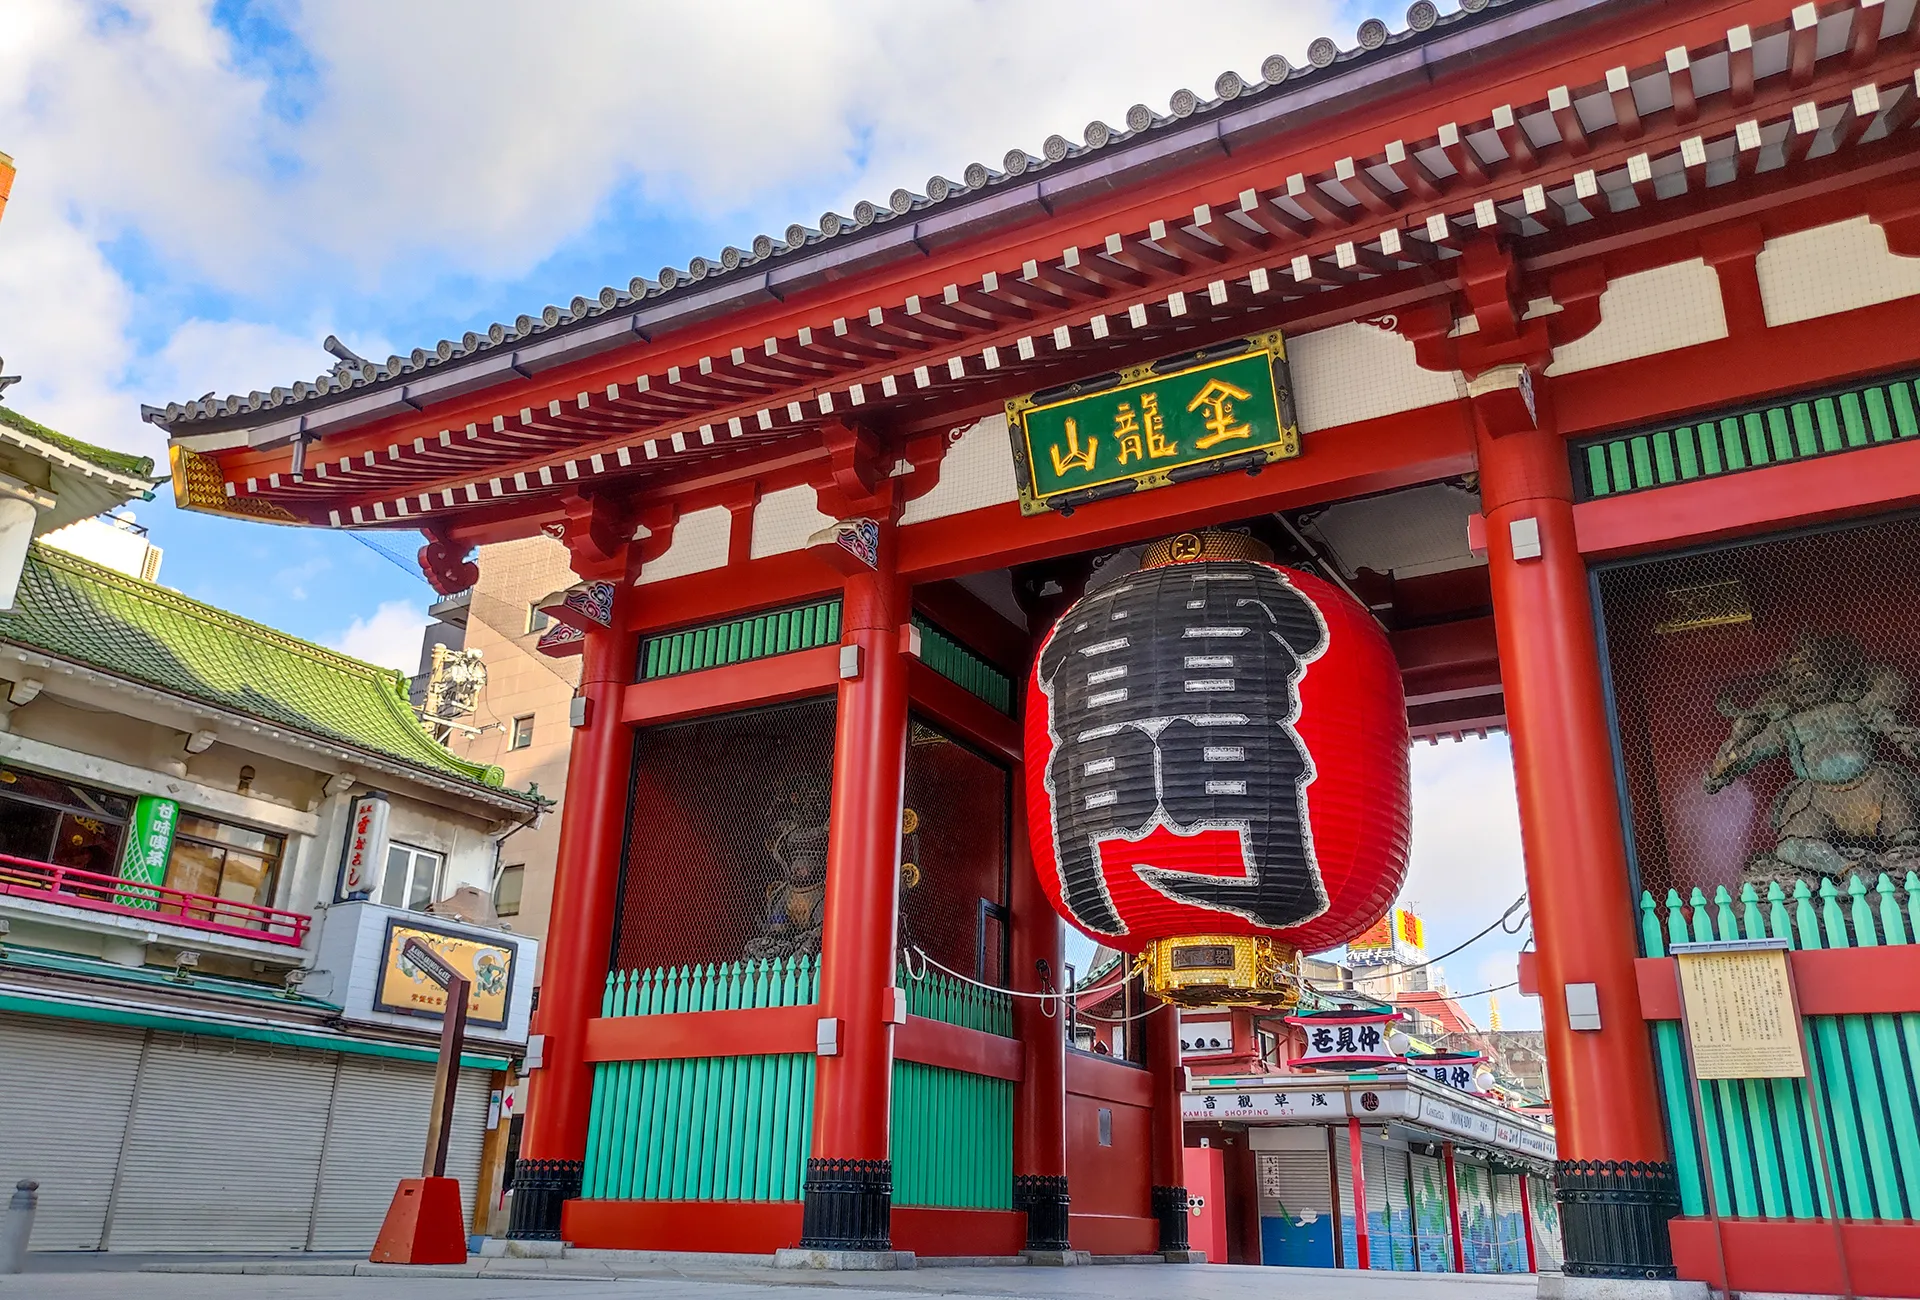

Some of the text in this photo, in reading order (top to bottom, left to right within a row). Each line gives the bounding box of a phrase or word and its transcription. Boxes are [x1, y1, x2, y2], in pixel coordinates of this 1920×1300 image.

[1037, 560, 1331, 936] 雷門
[146, 803, 175, 868] 甘味喫茶
[1415, 1066, 1470, 1089] 仲見
[1225, 1108, 1268, 1117] SHOPPING
